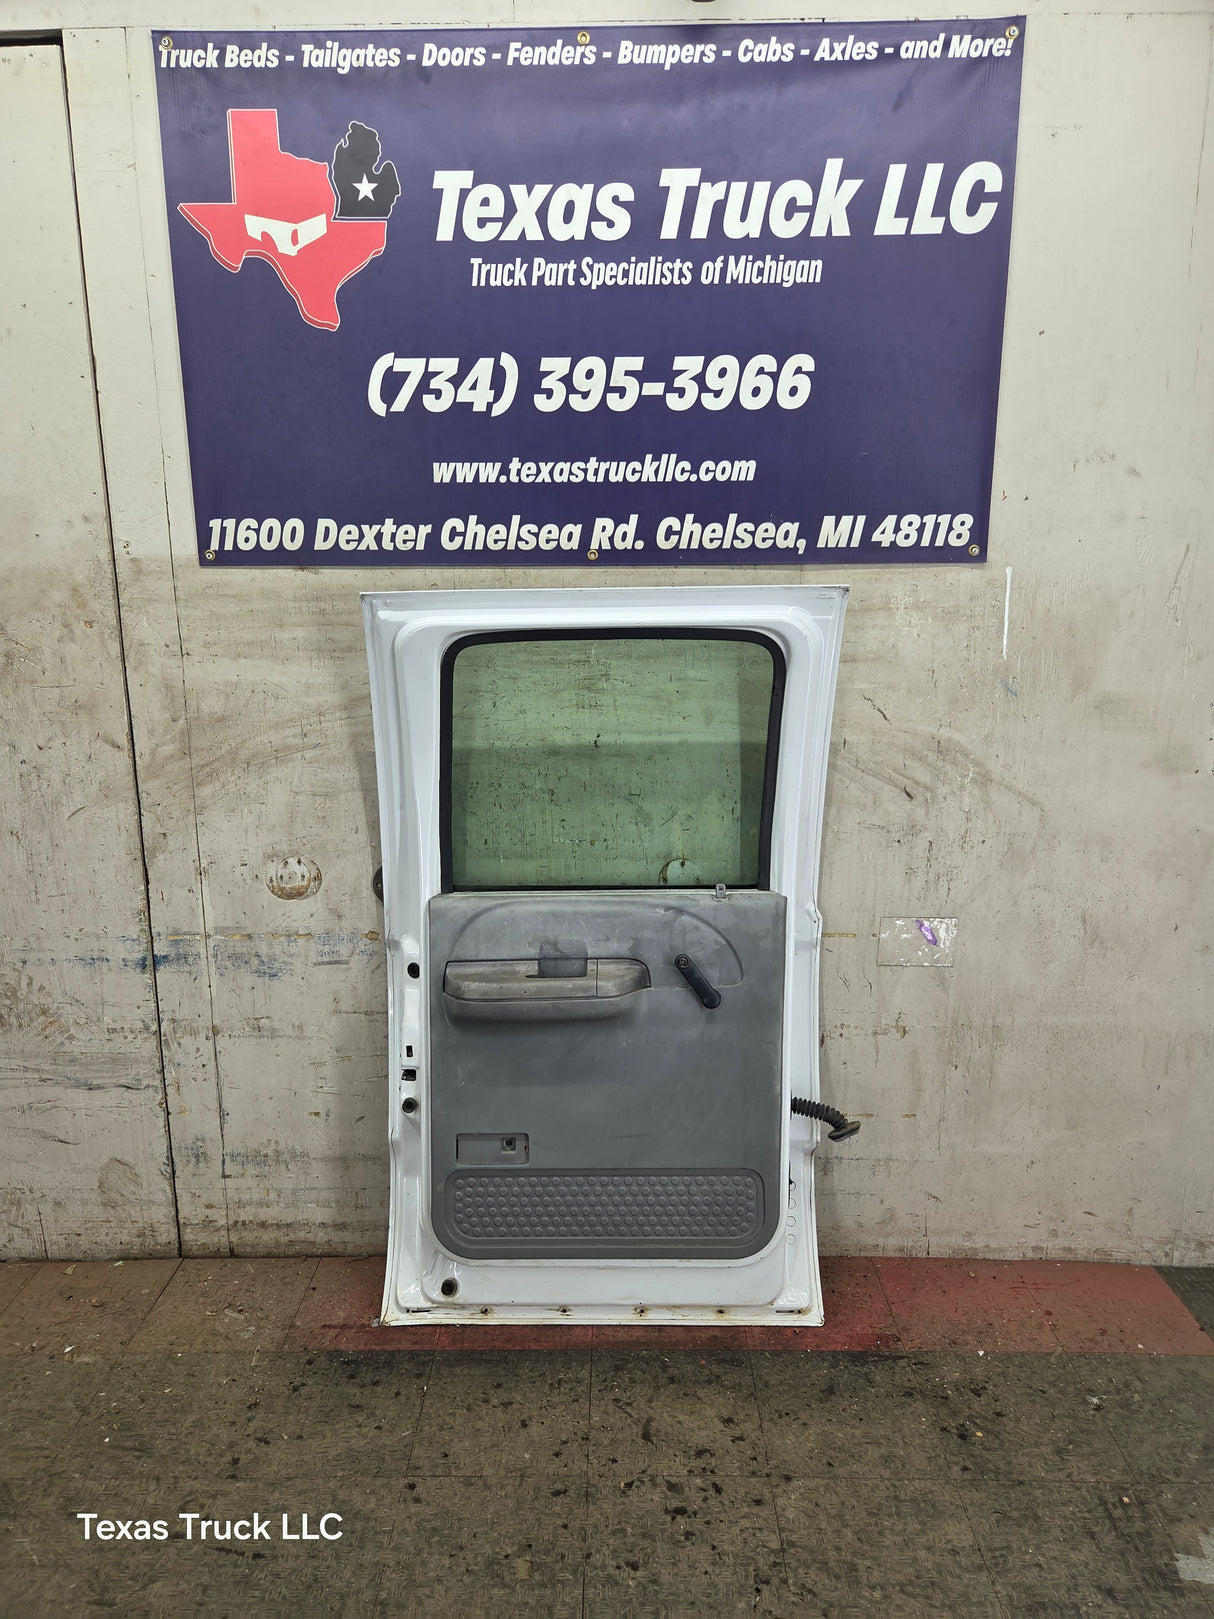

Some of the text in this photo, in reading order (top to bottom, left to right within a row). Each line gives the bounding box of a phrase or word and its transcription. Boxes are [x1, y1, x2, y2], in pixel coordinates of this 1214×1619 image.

[158, 42, 220, 68] Truck
[225, 42, 279, 68] Beds
[301, 43, 401, 74] Tailgates
[422, 43, 486, 67] Doors
[507, 39, 597, 66] Fenders
[617, 40, 717, 70] Bumpers
[738, 36, 795, 63] Cabs
[814, 35, 879, 61] Axles
[900, 33, 945, 59] and
[948, 33, 1014, 58] More!
[433, 158, 1003, 242] Texas Truck LLC
[470, 255, 823, 290] Truck Part Specialists of Michigan
[368, 351, 816, 418] (734) 395-3966
[432, 454, 757, 484] www.texastruckllc.com
[208, 513, 974, 555] 11600 Dexter Chelsea Rd. Chelsea, MI 48118
